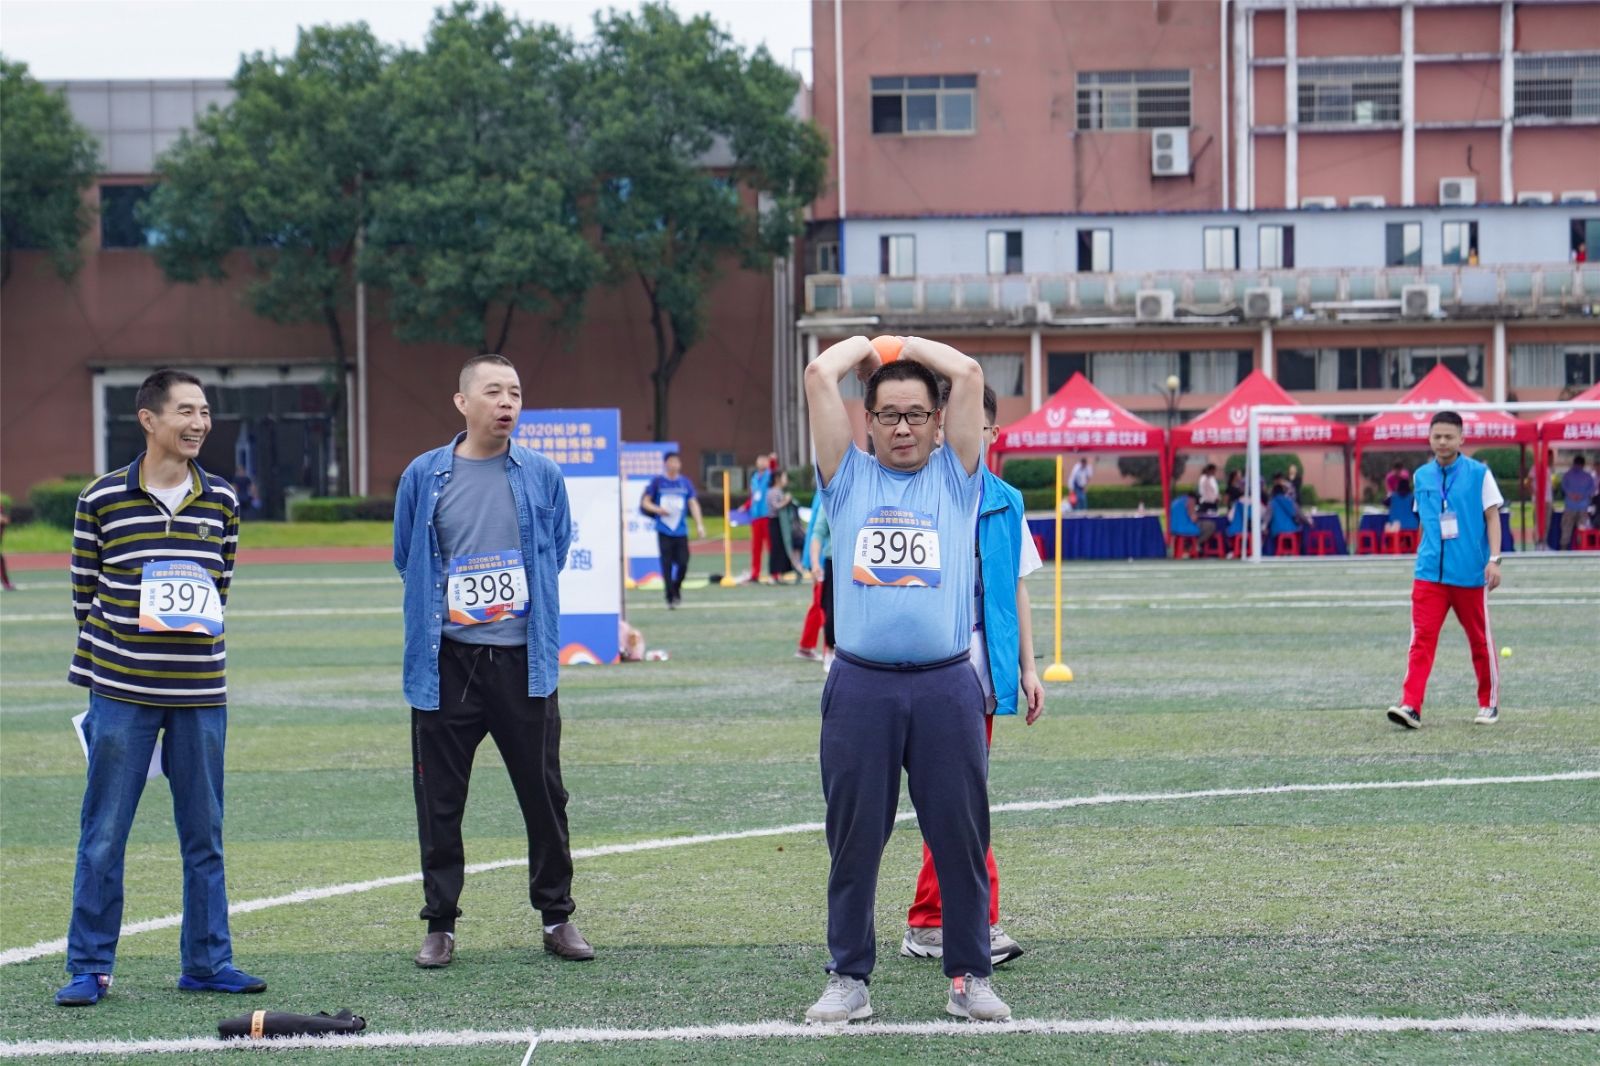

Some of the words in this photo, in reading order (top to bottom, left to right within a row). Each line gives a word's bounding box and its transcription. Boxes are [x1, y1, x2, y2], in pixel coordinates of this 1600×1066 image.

[518, 423, 592, 436] 2020长沙市
[1191, 425, 1332, 444] 战马能量维生素饮料
[1374, 423, 1517, 440] 战马能量生素饮料
[870, 530, 926, 565] 396
[159, 583, 210, 614] 397
[463, 572, 515, 606] 398
